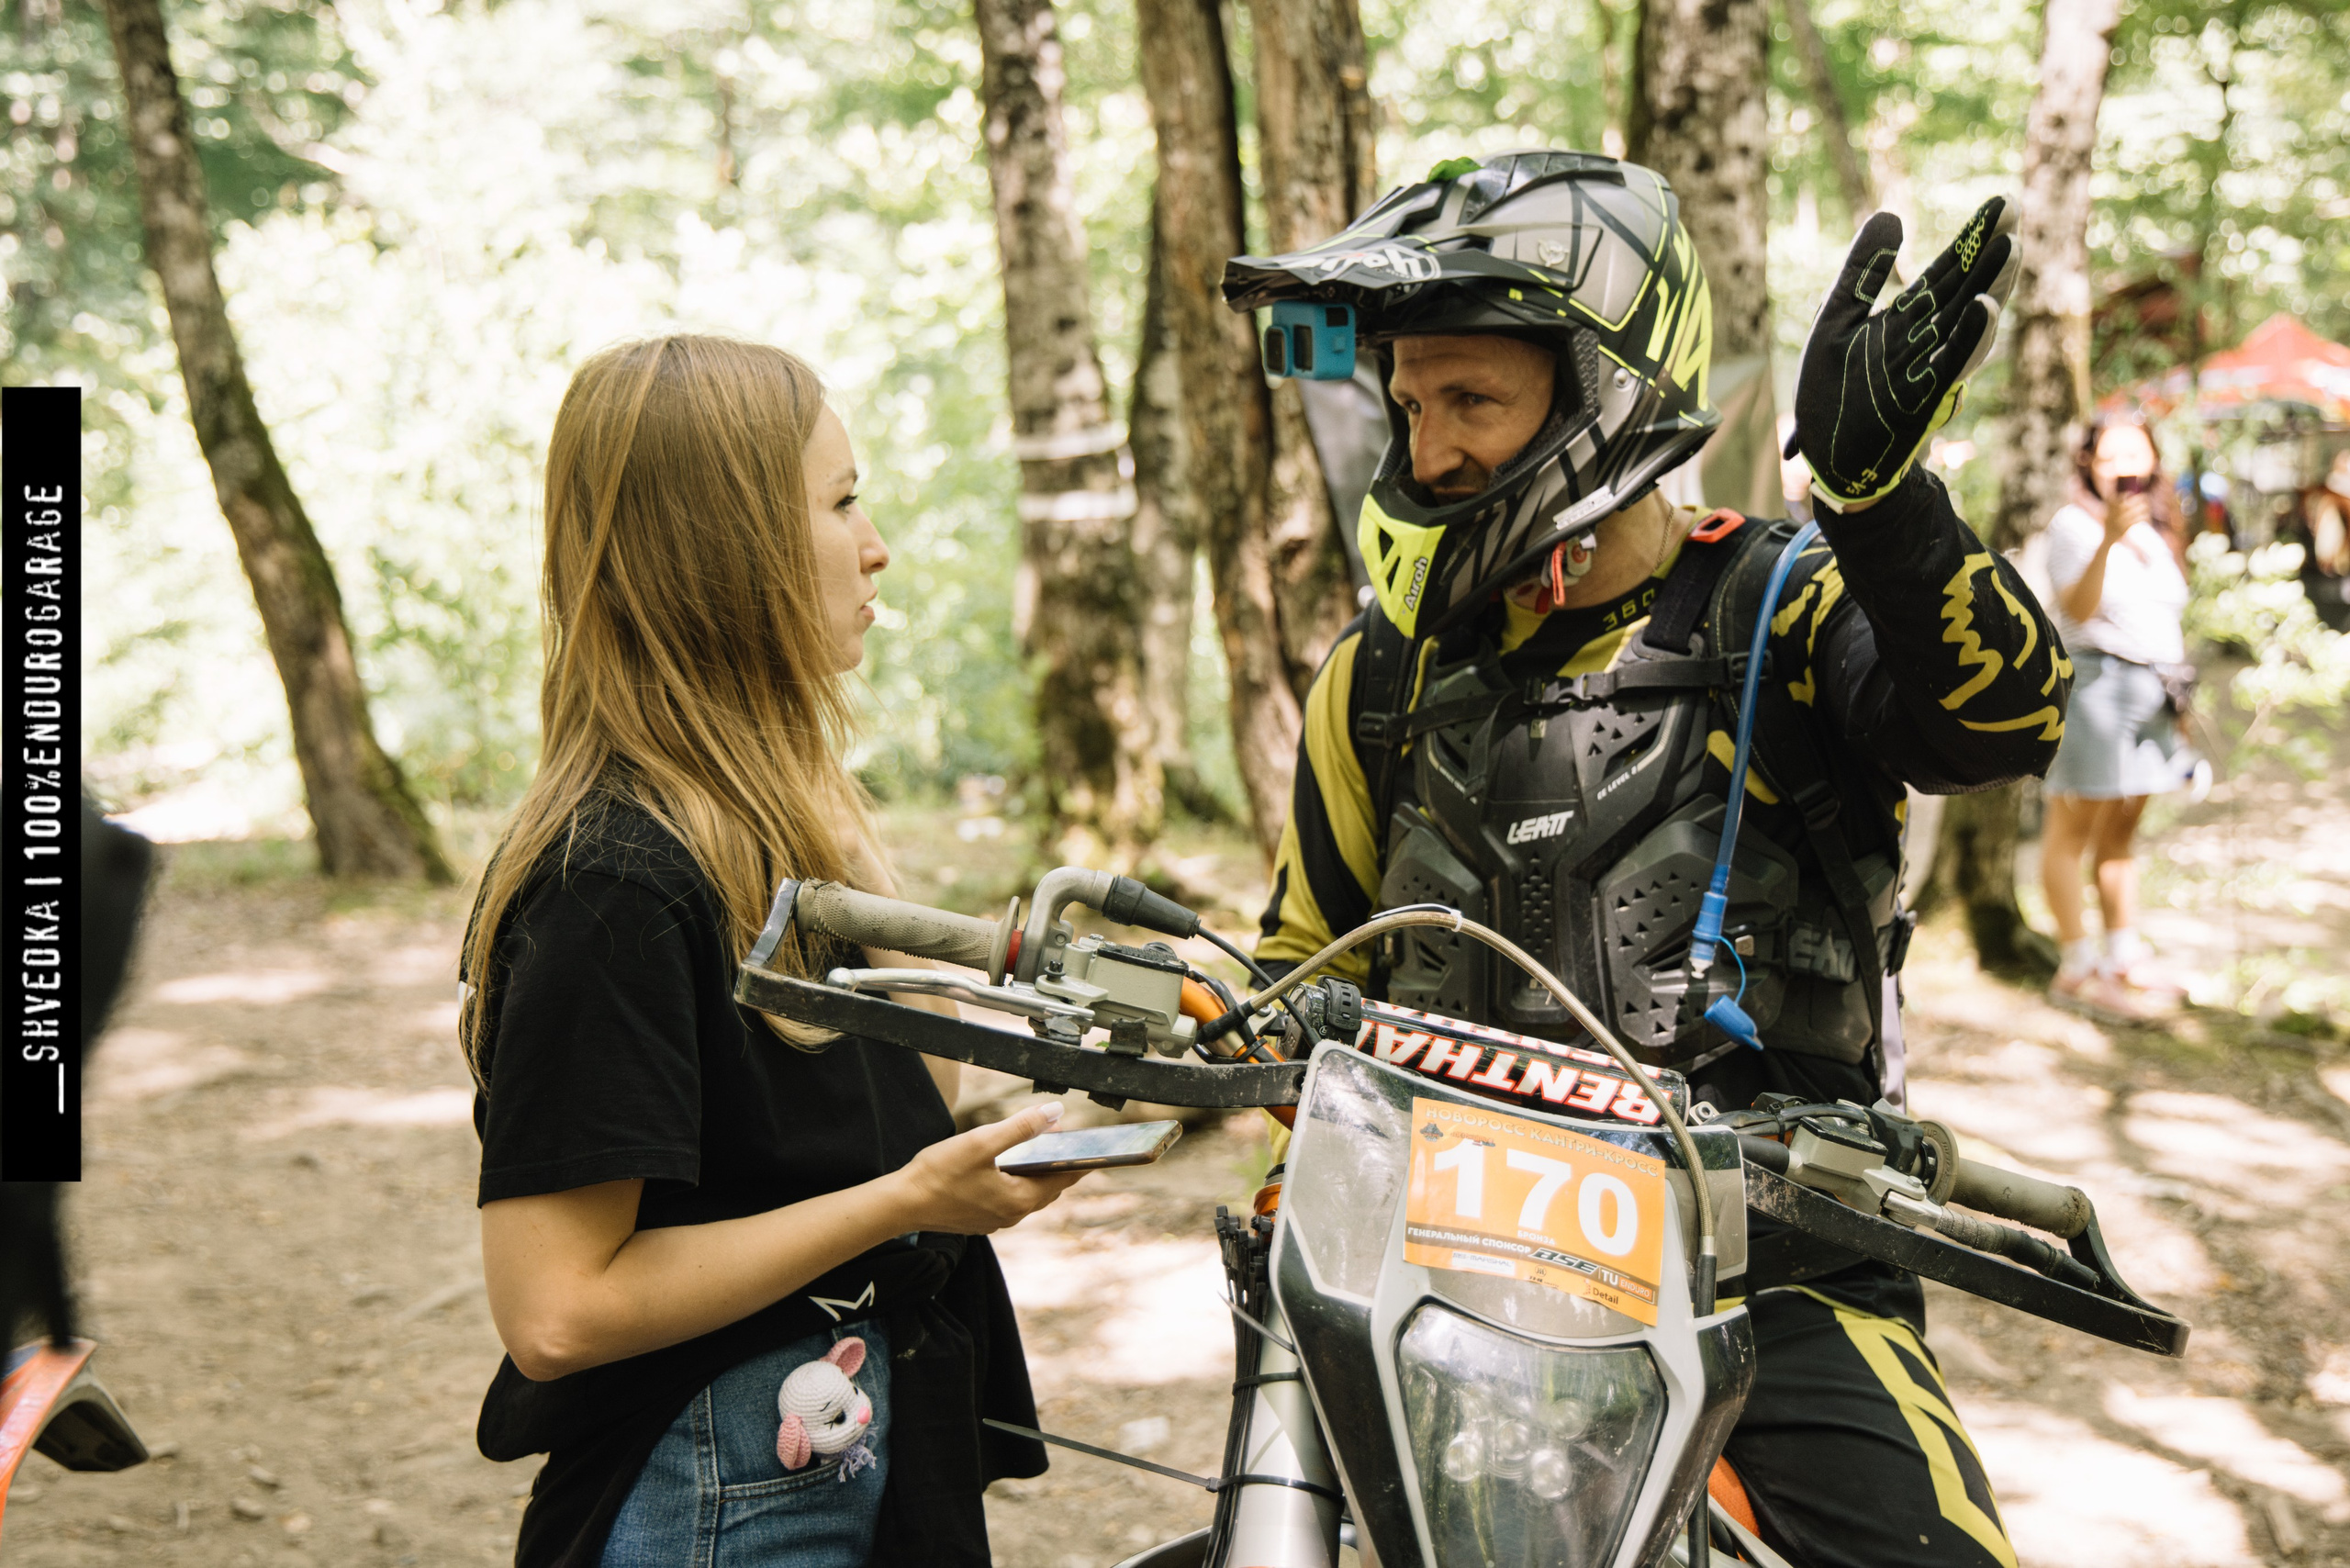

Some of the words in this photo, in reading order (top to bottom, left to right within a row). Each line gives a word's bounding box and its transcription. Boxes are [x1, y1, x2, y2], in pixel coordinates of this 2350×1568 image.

[1506, 810, 1574, 845] LEATT
[1426, 1105, 1526, 1137] НОВОРОСС
[1529, 1127, 1659, 1177] КАНТРИ-КРОСС
[1434, 1137, 1639, 1257] 170
[1407, 1226, 1480, 1245] ГЕНЕРАЛЬНЫЙ
[1481, 1238, 1532, 1254] СПОНСОР
[1516, 1229, 1556, 1247] БРОНЗА
[1528, 1247, 1599, 1275] BSE
[1593, 1287, 1619, 1305] Detail
[1601, 1269, 1619, 1286] TU
[1619, 1280, 1651, 1298] ENDURO
